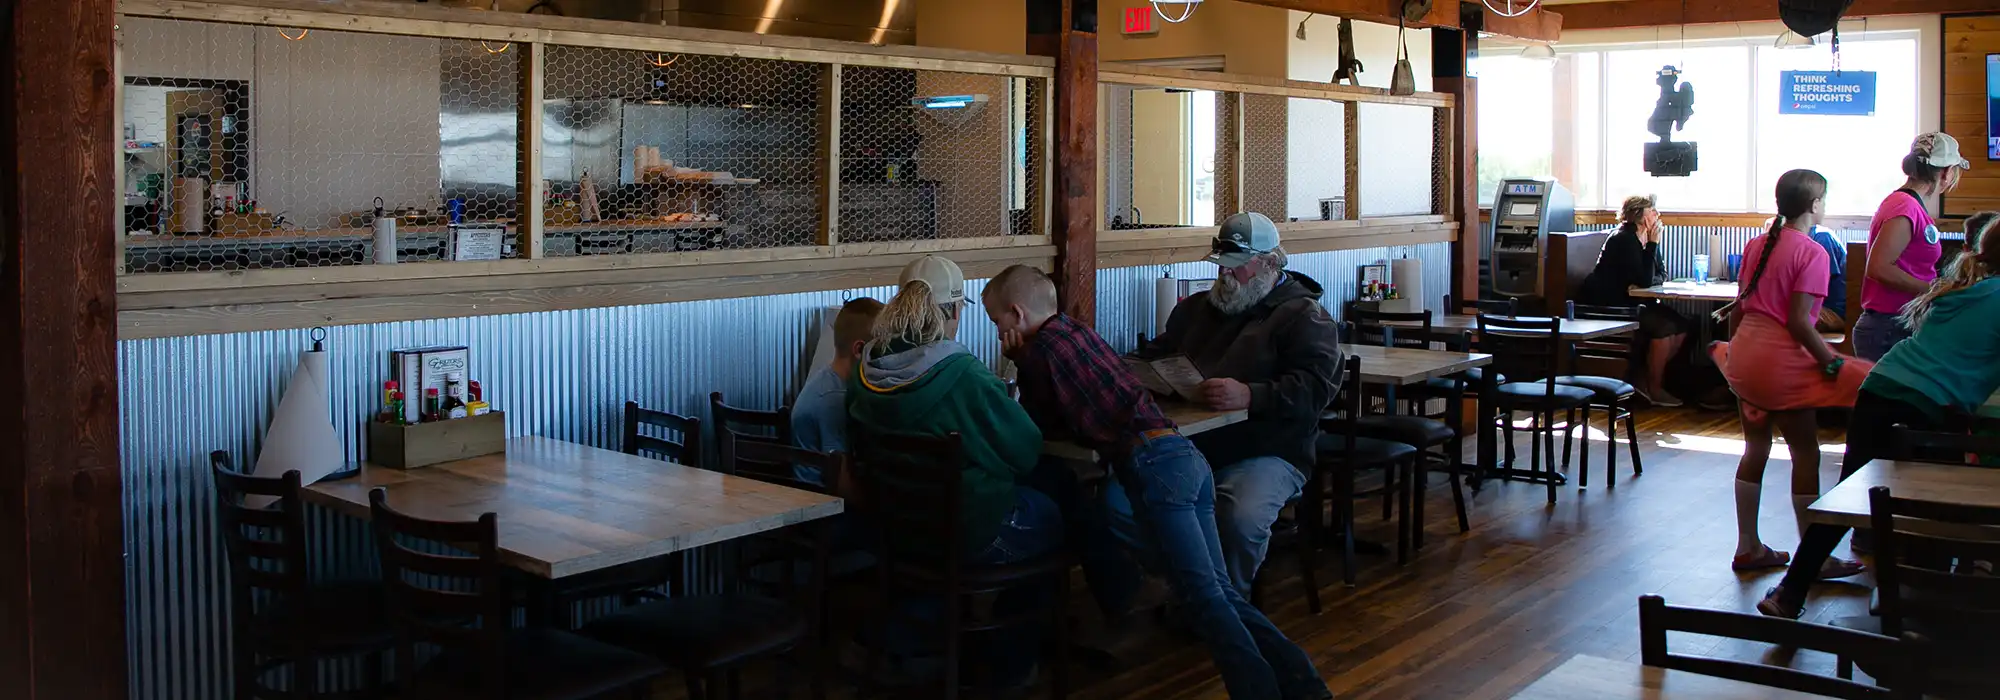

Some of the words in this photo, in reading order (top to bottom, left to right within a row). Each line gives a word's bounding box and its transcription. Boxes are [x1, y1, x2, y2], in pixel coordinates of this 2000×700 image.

[1125, 6, 1152, 32] EXIT
[1793, 75, 1827, 83] THINK
[1793, 84, 1860, 93] REFRESHING
[1793, 93, 1853, 102] THOUGHTS
[1515, 184, 1536, 193] ATM
